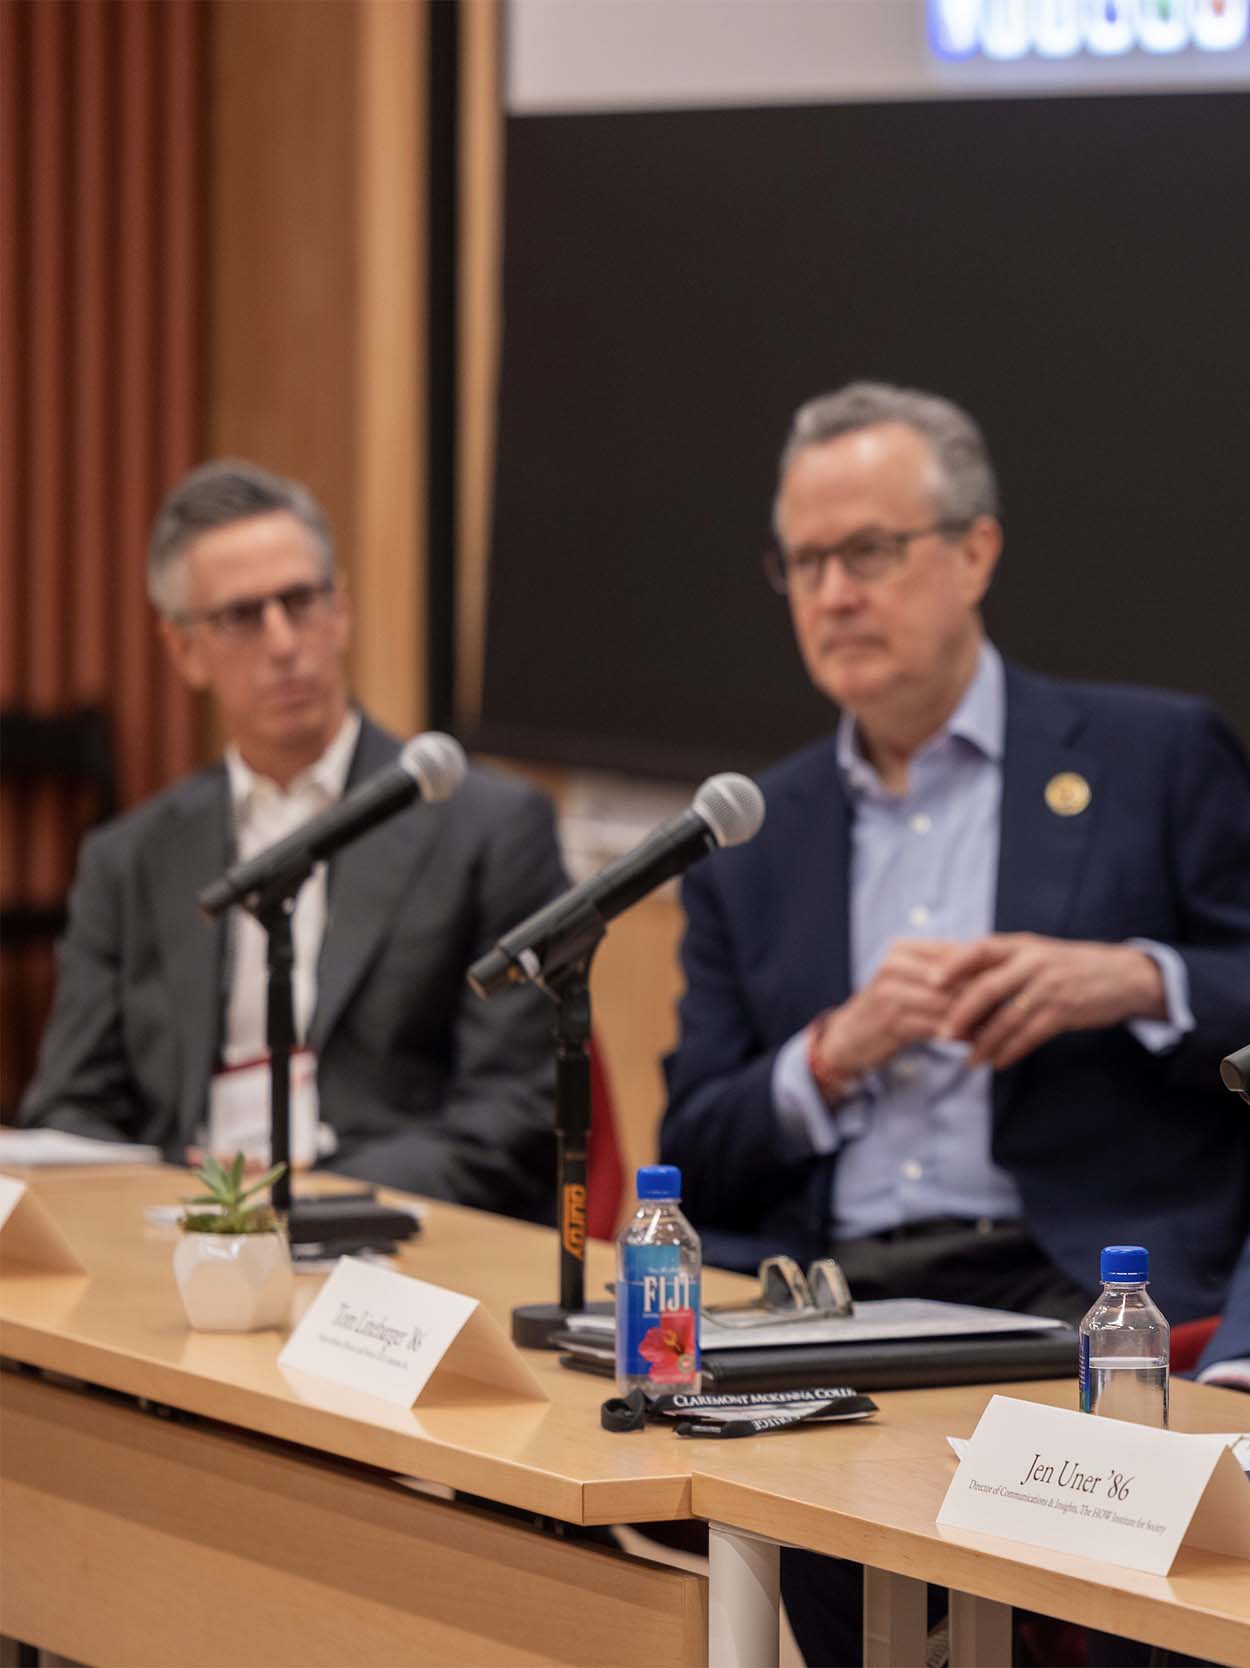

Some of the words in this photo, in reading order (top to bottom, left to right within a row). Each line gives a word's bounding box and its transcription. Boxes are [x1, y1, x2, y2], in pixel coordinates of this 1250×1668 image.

[643, 1273, 690, 1312] FIJI
[673, 1393, 749, 1407] CLAREMONT
[1020, 1453, 1054, 1486] Jen
[1058, 1460, 1102, 1494] Uner
[1107, 1469, 1136, 1502] ’86
[969, 1479, 993, 1493] Director
[992, 1485, 1001, 1495] of
[1000, 1486, 1048, 1506] Communications
[1080, 1503, 1092, 1517] The
[1092, 1507, 1112, 1520] HOW
[1146, 1519, 1167, 1536] Society
